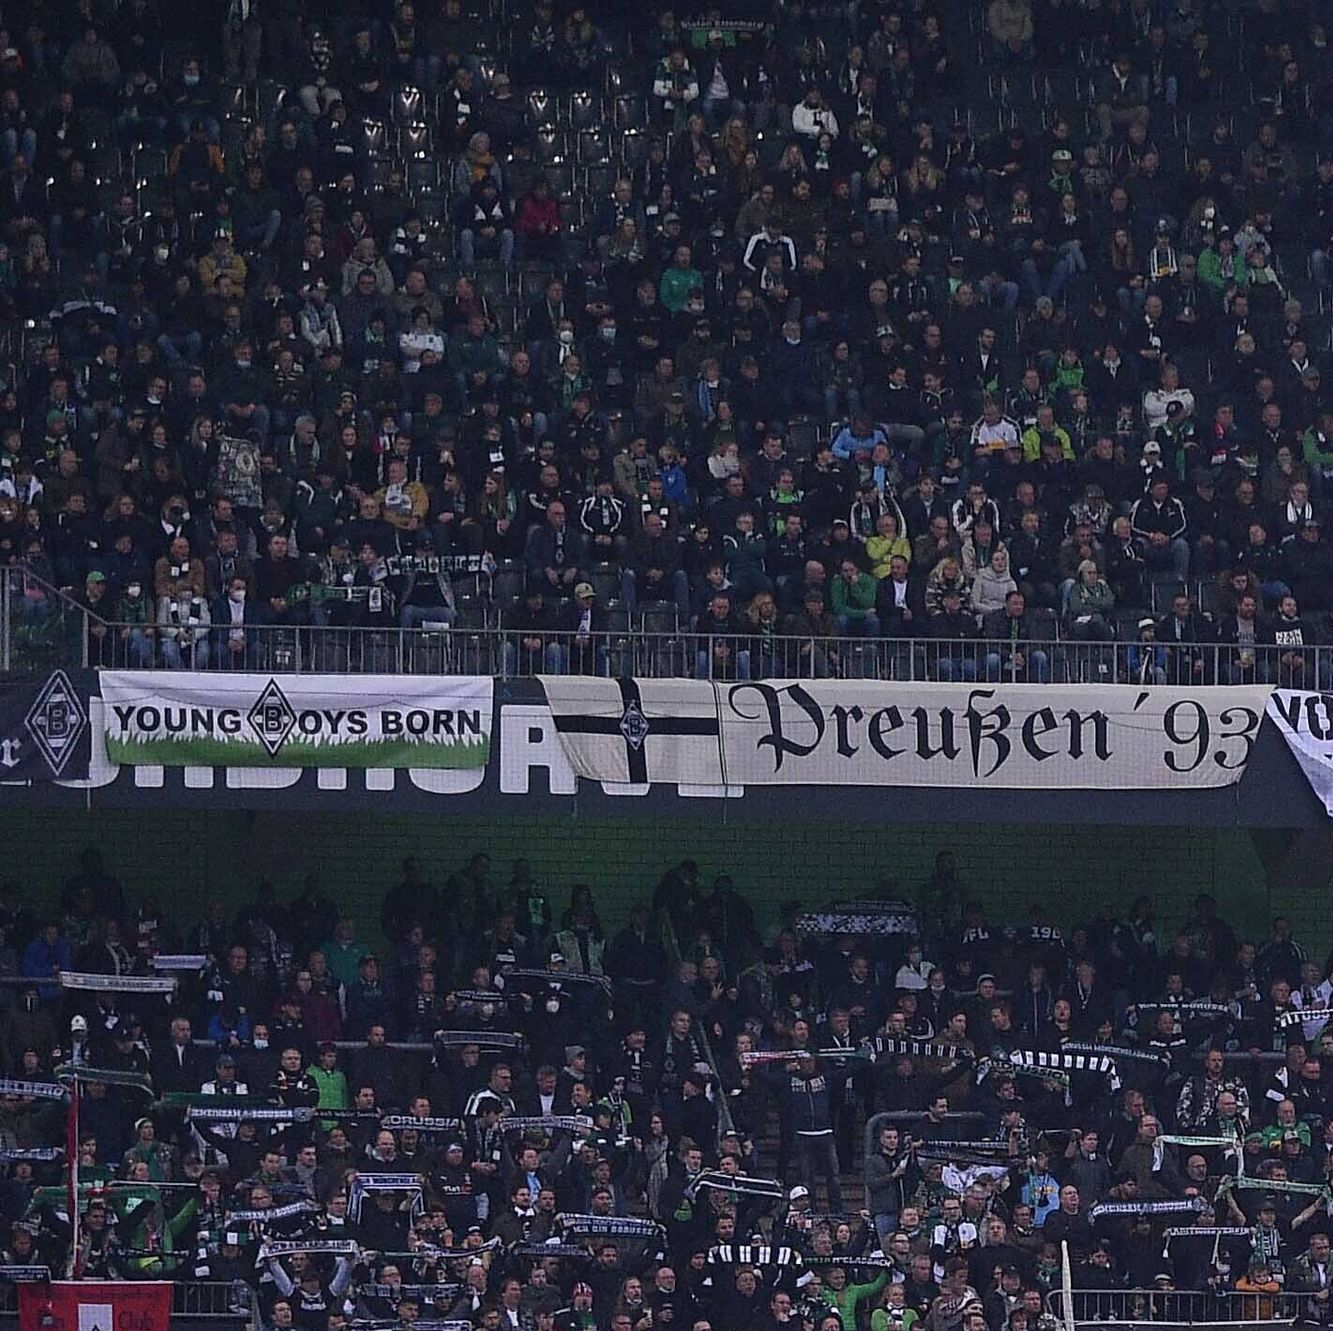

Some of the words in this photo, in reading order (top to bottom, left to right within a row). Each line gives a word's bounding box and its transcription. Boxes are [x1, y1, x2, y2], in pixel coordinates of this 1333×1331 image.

[114, 706, 242, 734] YOUNG
[380, 709, 481, 737] BORN
[728, 682, 1113, 777] Preußen
